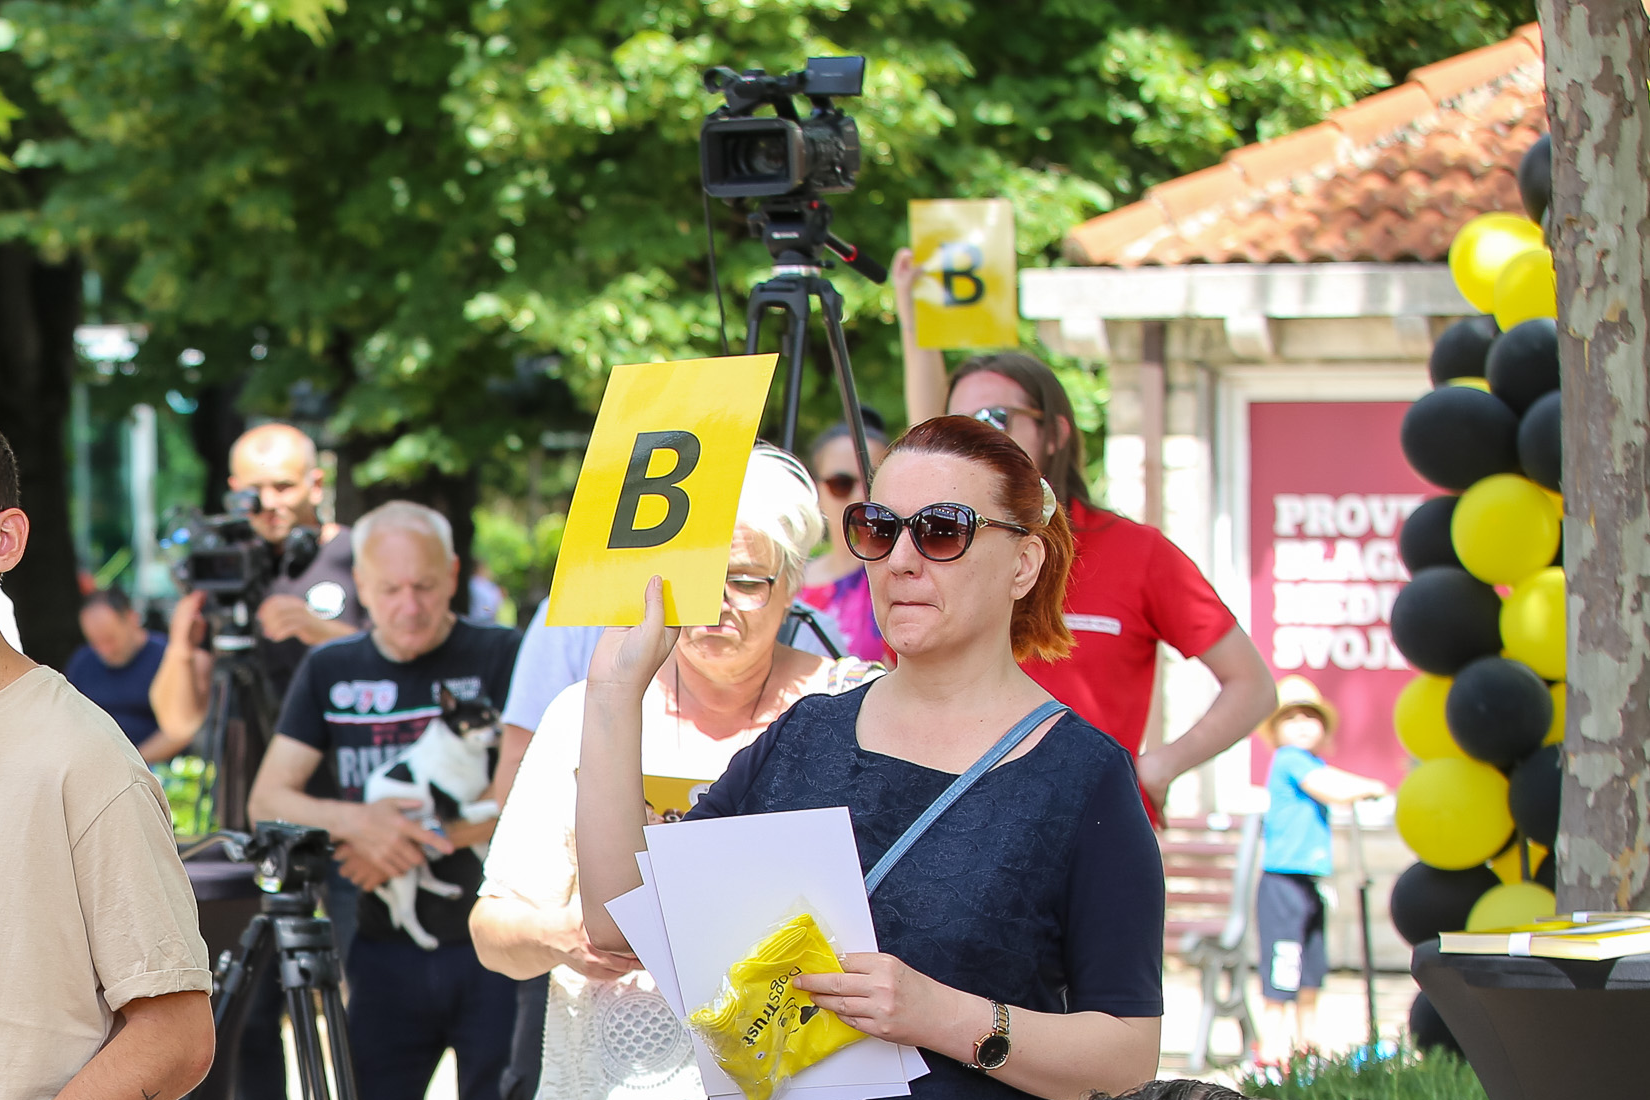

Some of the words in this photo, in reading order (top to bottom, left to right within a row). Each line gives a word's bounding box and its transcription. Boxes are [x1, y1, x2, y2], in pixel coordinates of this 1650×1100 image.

[941, 242, 985, 307] B
[608, 430, 701, 549] B
[1273, 539, 1412, 581] BLAG
